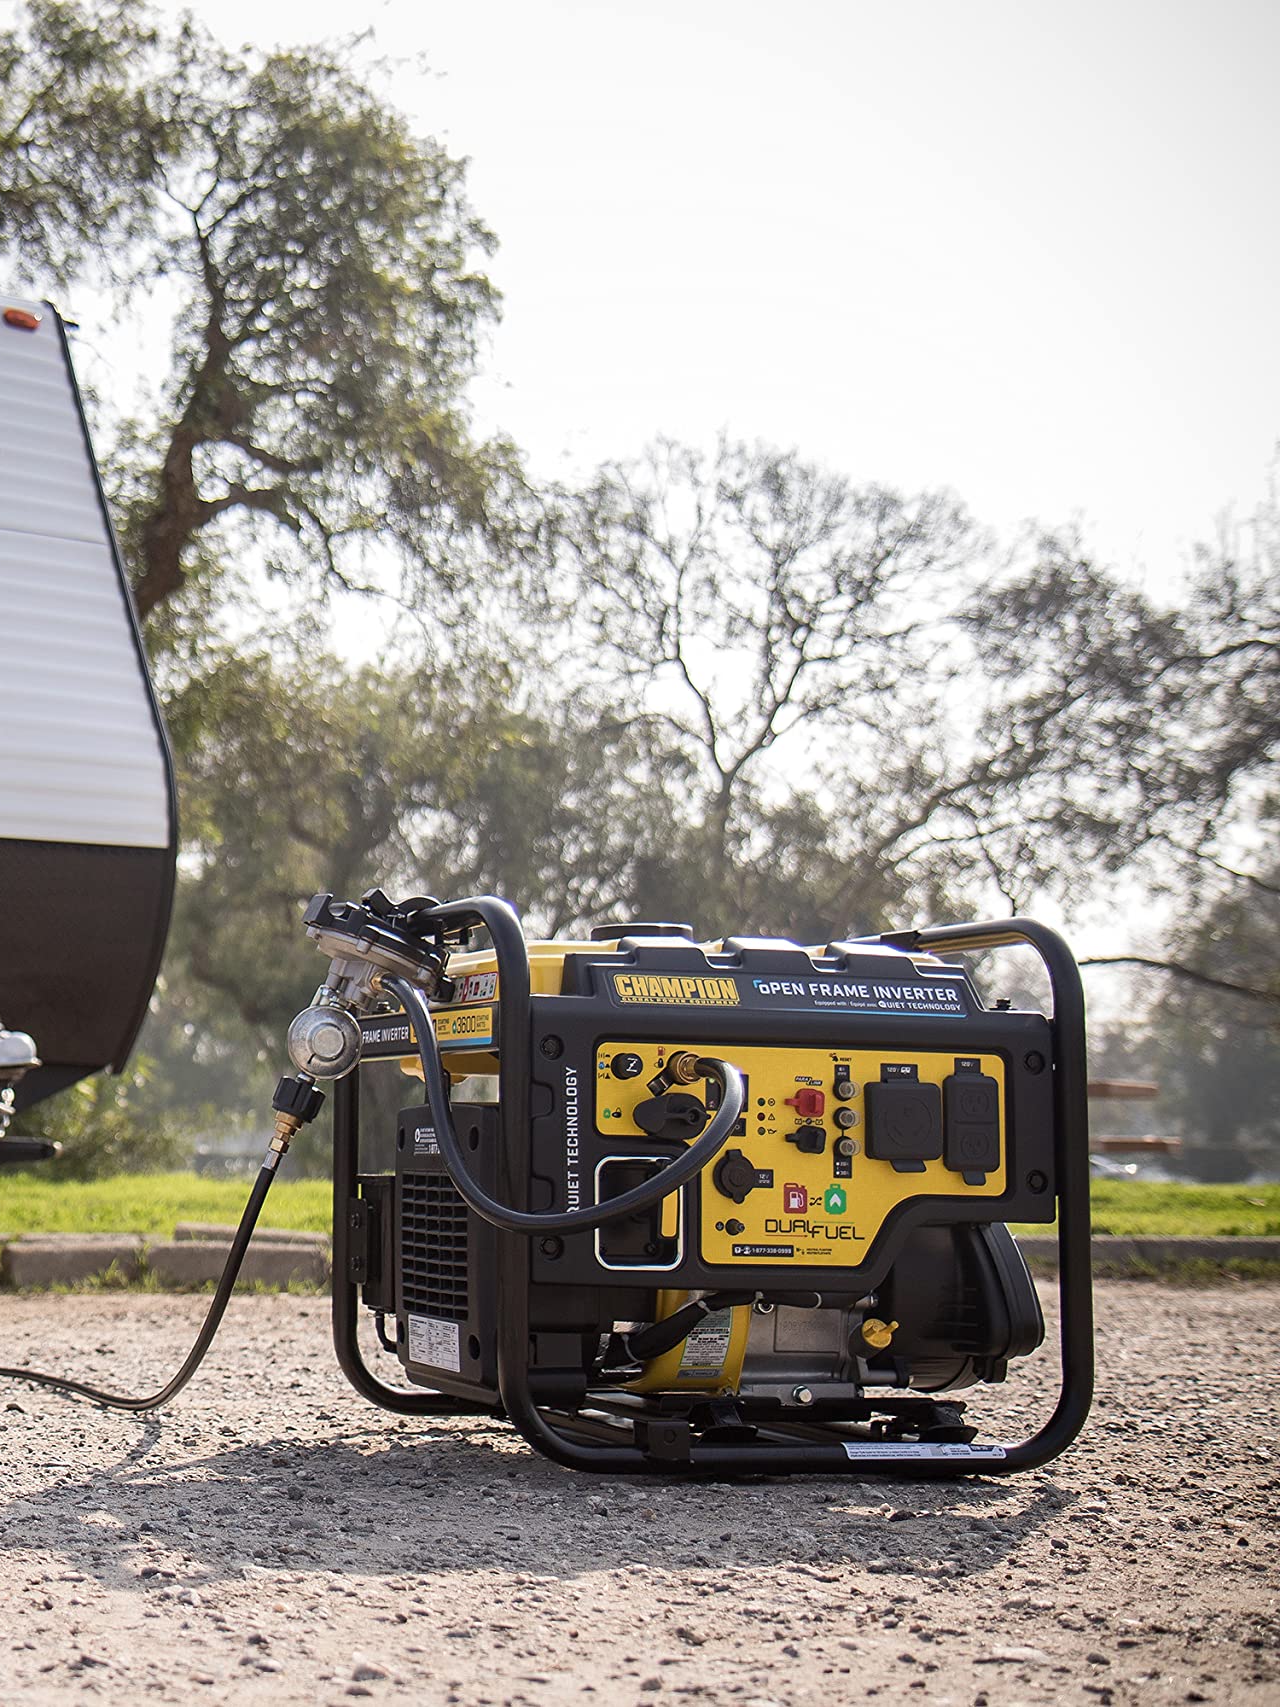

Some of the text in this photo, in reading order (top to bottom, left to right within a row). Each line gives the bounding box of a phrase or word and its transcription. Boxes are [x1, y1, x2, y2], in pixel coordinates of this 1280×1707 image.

[615, 975, 740, 1000] CHAMPION
[756, 981, 959, 1002] OPEN FRAME INVERTER
[878, 1000, 905, 1009] QUIET
[907, 1002, 961, 1011] TECHNOLOGY
[362, 1026, 410, 1044] FRAME INVERTER
[456, 1015, 477, 1035] 3600
[565, 1066, 579, 1166] TECHNOLOGY
[765, 1219, 865, 1241] DUAL FUEL
